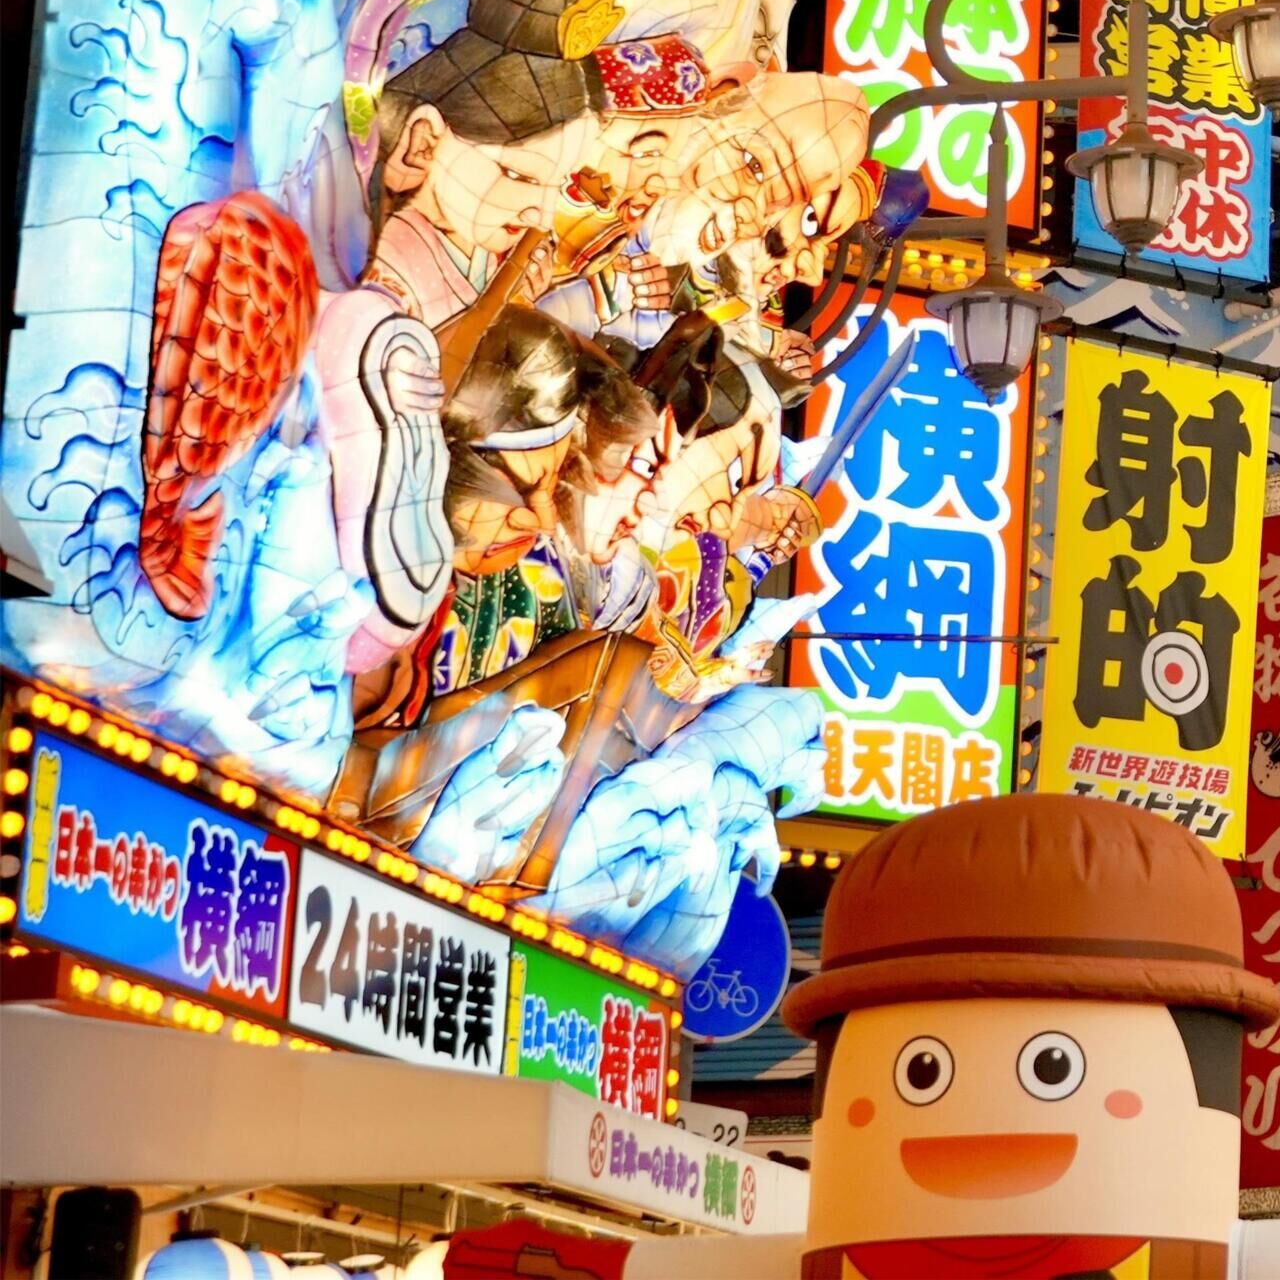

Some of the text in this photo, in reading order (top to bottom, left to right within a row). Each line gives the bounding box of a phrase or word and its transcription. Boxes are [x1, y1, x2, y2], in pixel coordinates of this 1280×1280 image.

[1074, 368, 1253, 751] 射的
[1068, 746, 1231, 795] 新世界遊技場
[54, 809, 179, 917] 日本一の串かつ
[181, 823, 288, 996] 横綱
[300, 884, 496, 1067] 24時間営業
